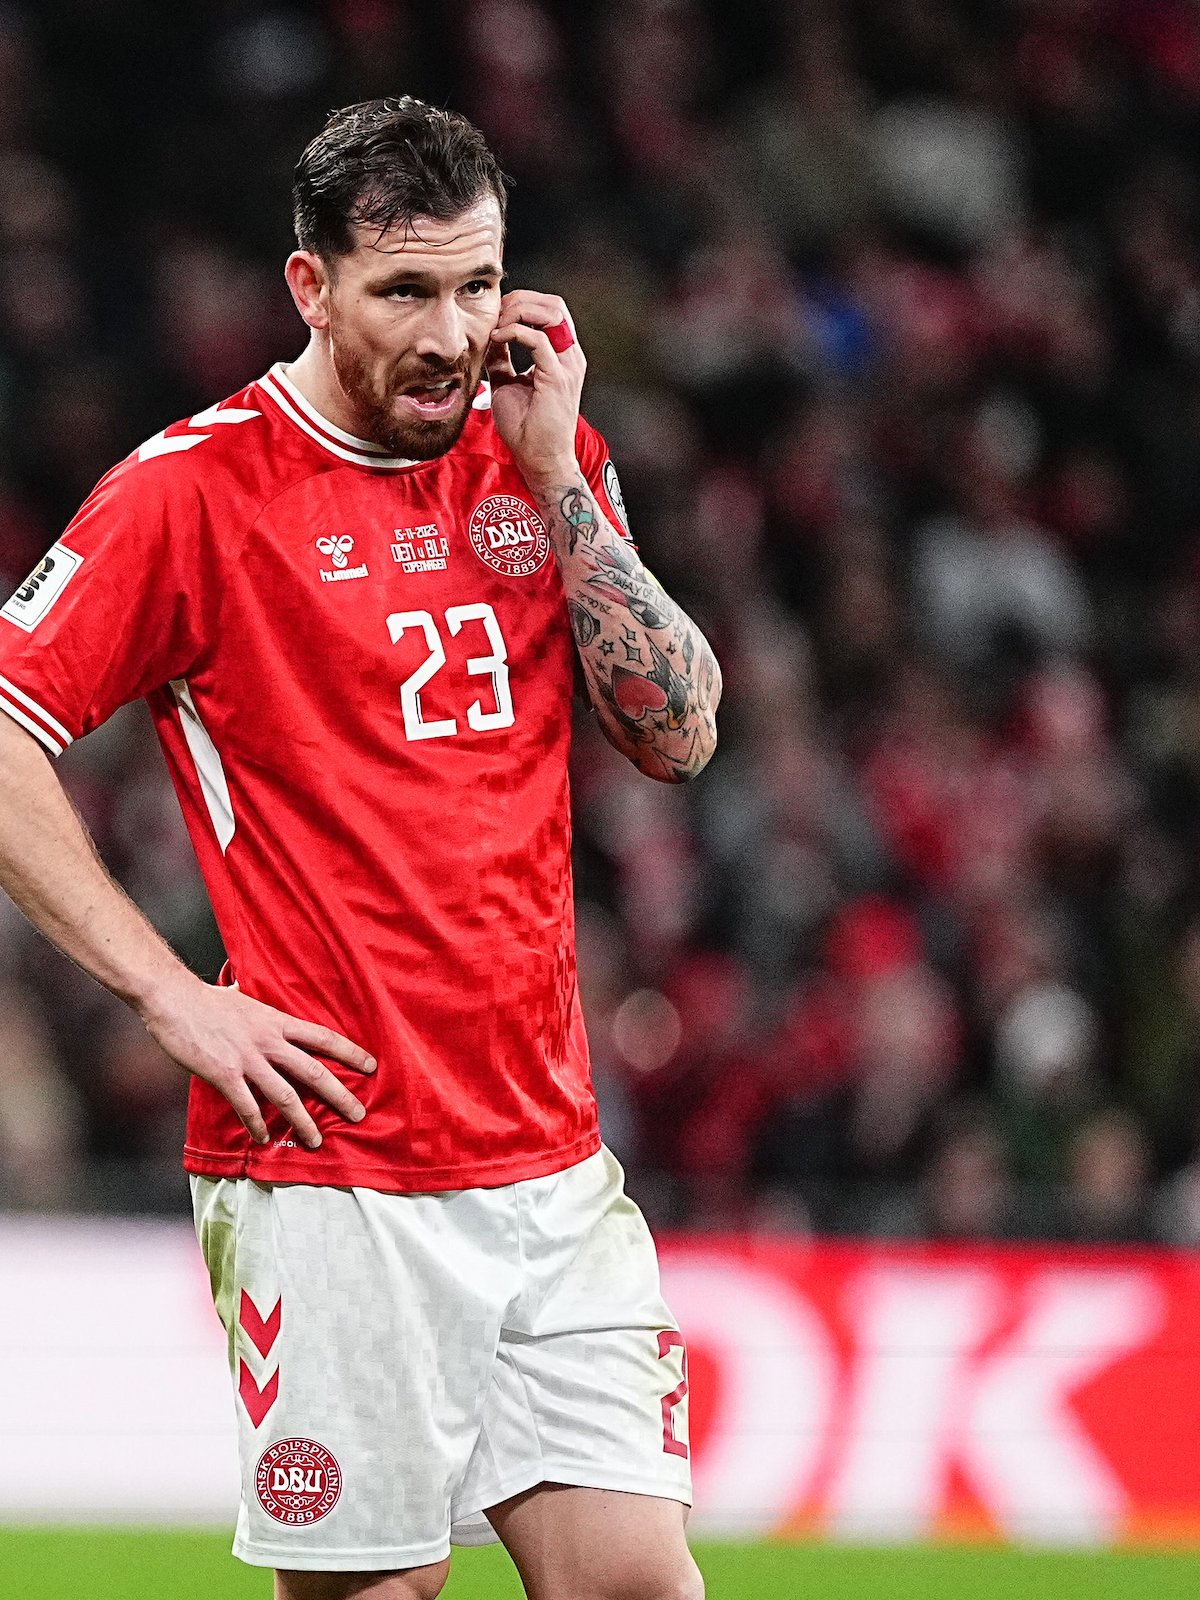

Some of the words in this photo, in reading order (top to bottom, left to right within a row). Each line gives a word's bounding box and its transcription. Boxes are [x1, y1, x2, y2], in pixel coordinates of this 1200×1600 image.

[393, 523, 439, 541] 15-11-2025
[484, 519, 535, 549] DBU
[390, 541, 417, 562] DEN
[423, 537, 451, 559] BLR
[472, 524, 502, 568] DANSK
[319, 562, 369, 582] hummel
[401, 558, 448, 573] COPENHAGEN
[506, 559, 537, 574] 1889
[386, 602, 516, 741] 23
[258, 1460, 277, 1511] DANSK
[271, 1466, 322, 1493] DBU
[279, 1510, 315, 1522] 1889
